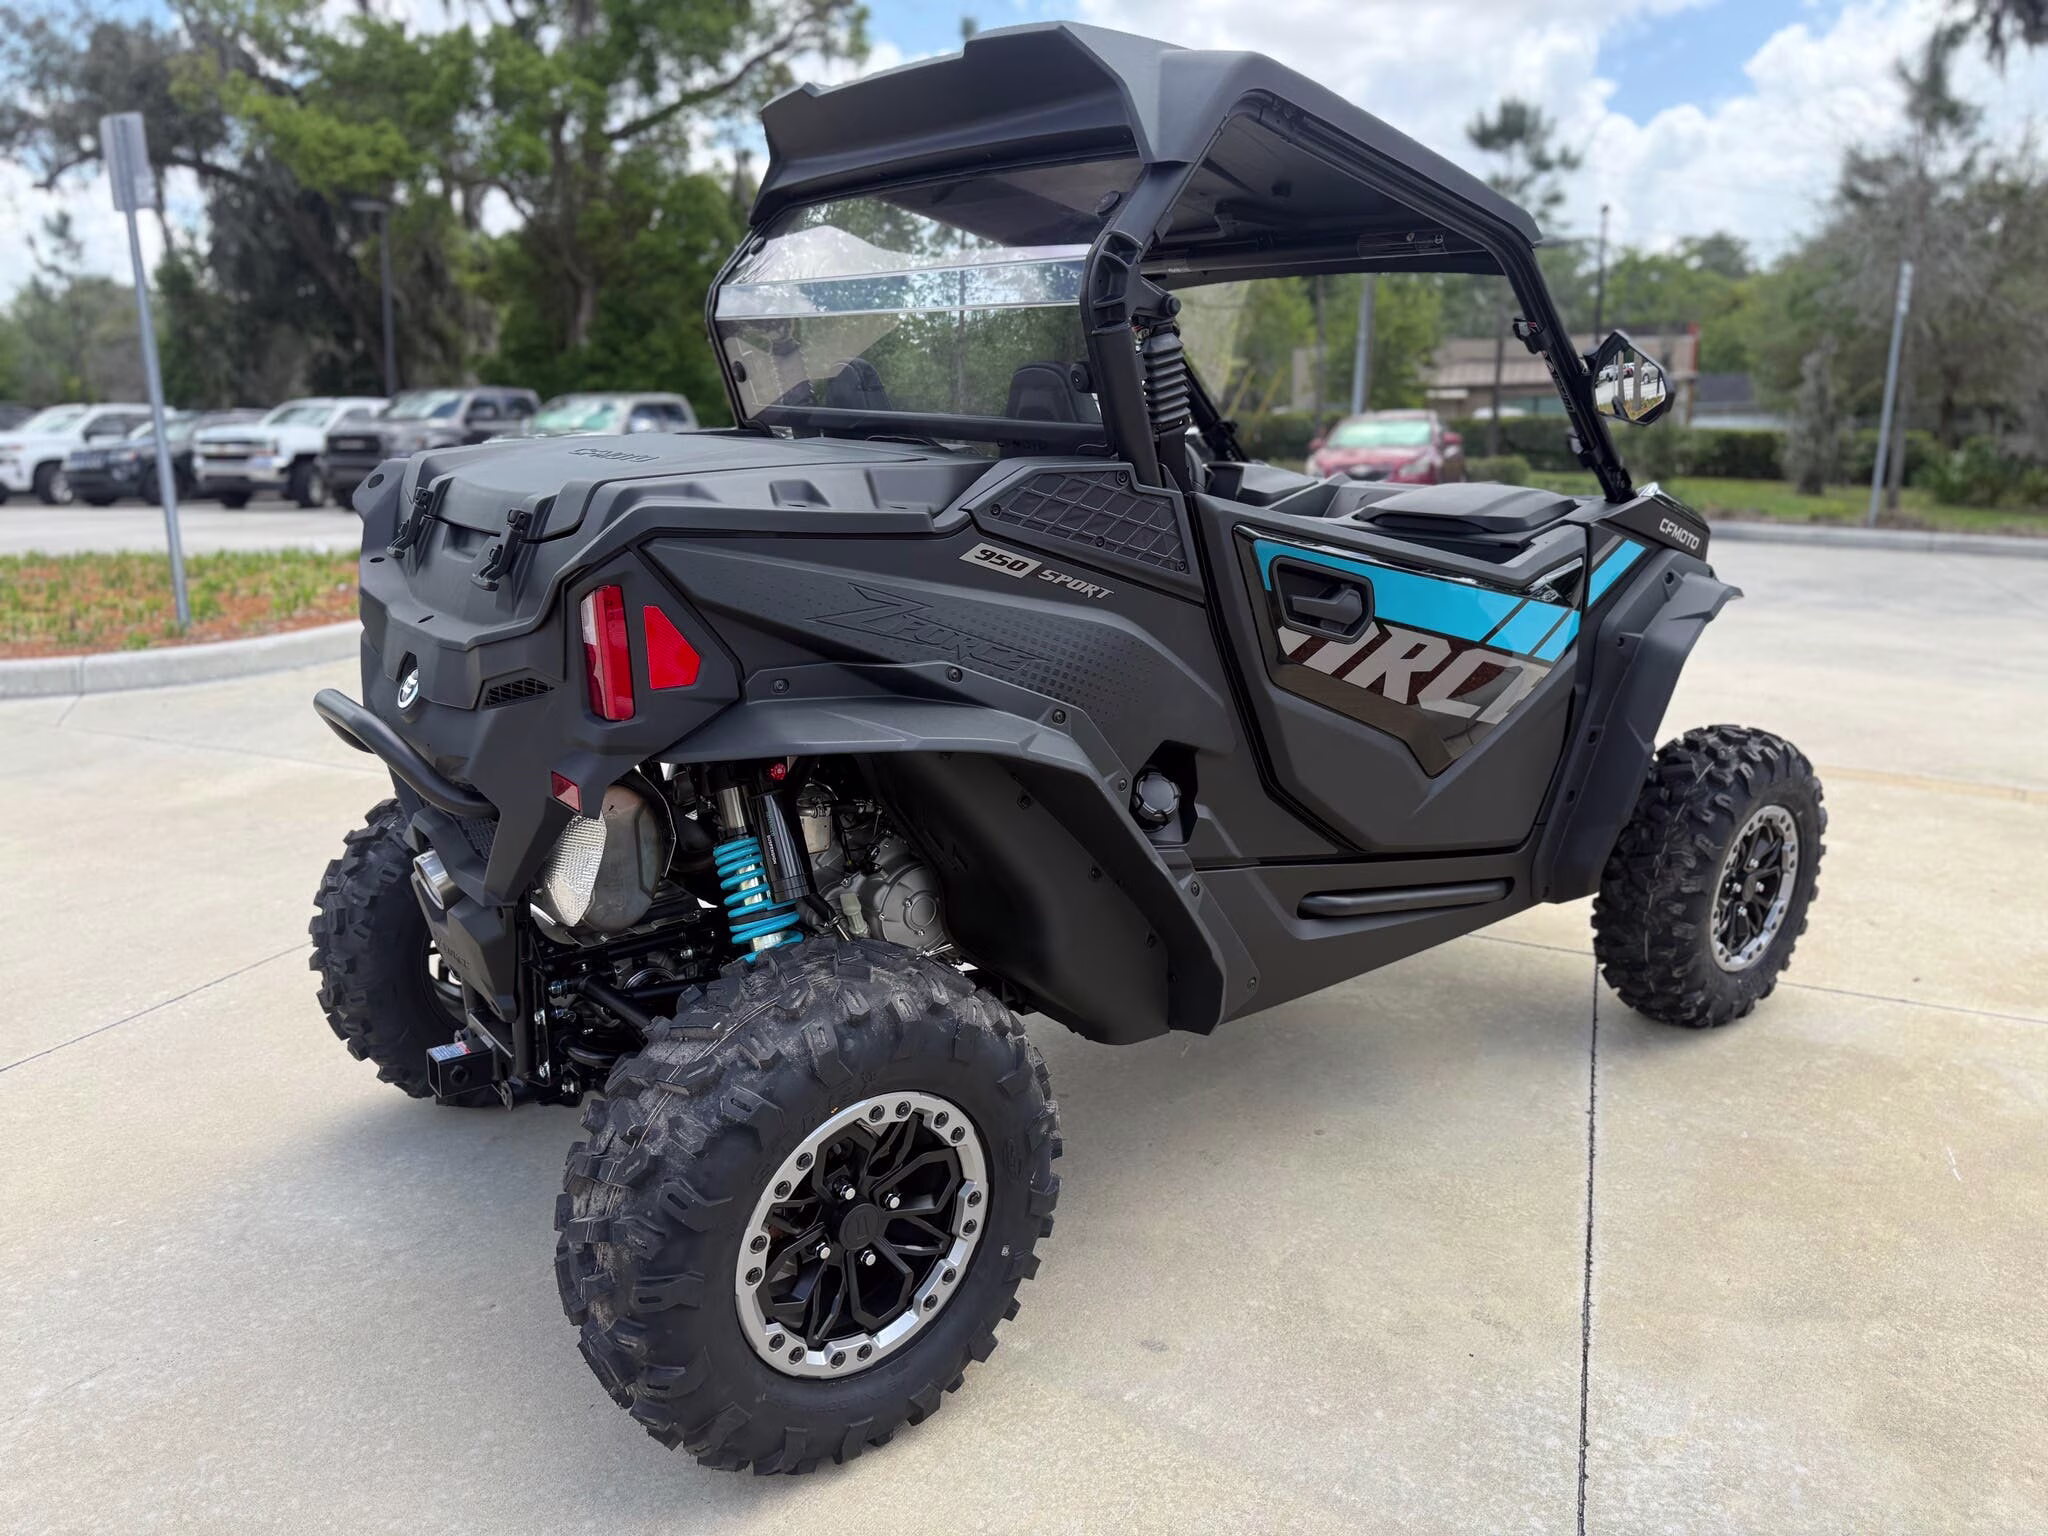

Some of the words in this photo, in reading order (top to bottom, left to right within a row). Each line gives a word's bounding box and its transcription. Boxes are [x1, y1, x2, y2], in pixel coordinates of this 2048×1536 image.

[1659, 517, 1700, 550] CFMOTO
[974, 549, 1030, 572] 950
[1038, 569, 1115, 599] SPORT
